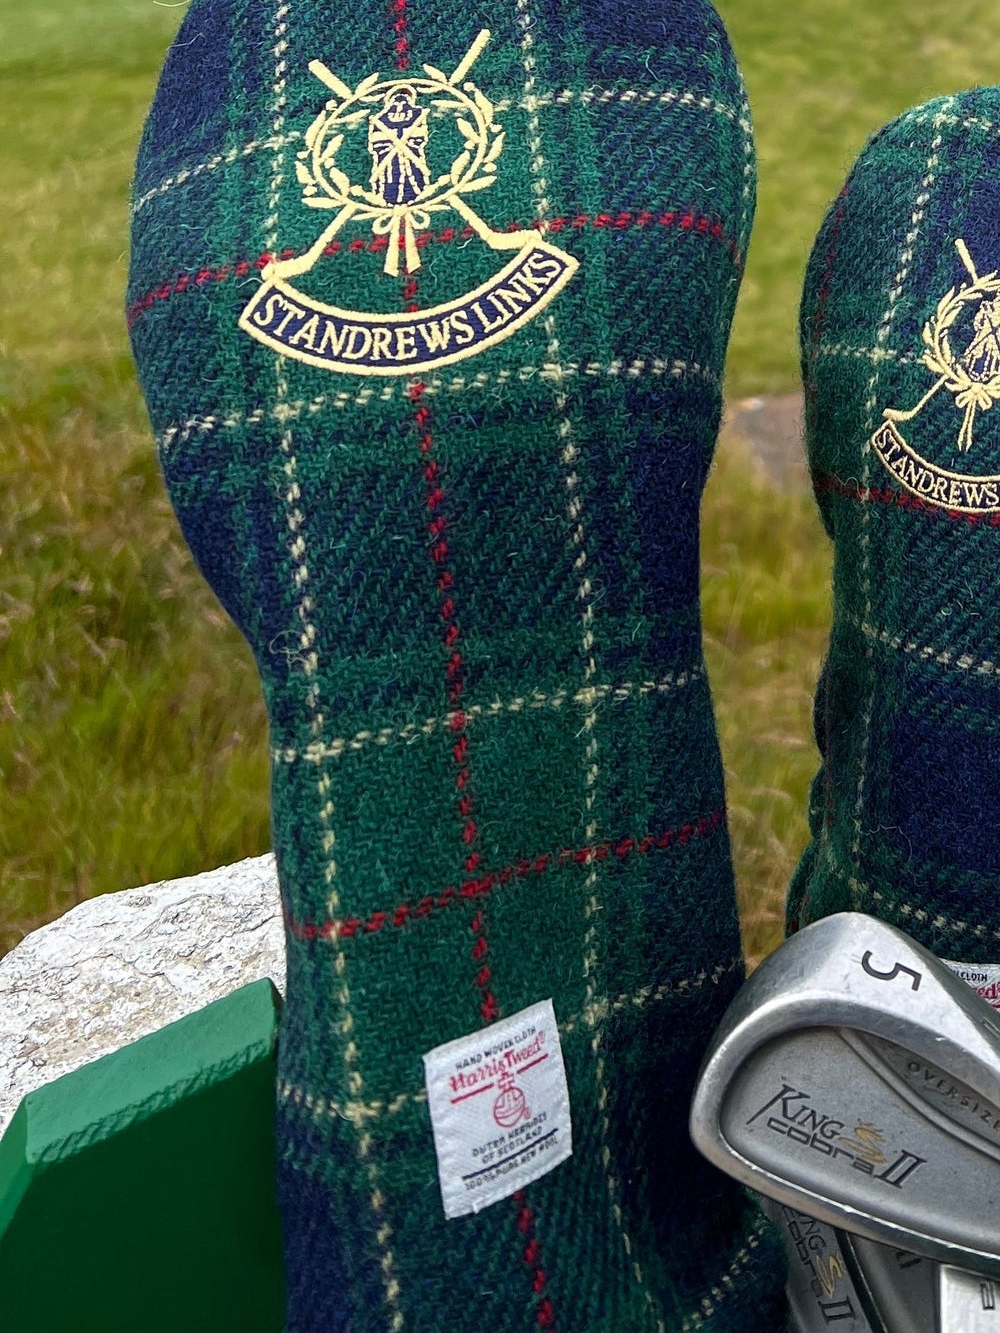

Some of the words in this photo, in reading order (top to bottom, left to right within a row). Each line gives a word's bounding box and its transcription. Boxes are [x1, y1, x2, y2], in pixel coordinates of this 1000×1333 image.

[253, 293, 306, 338] ST
[289, 309, 476, 361] ANDREWS
[473, 252, 563, 334] LINKS
[876, 428, 901, 462] ST
[891, 455, 1000, 507] ANDREWS
[861, 950, 923, 992] 5
[455, 1053, 483, 1071] HAND
[484, 1039, 514, 1057] WOVEN
[514, 1026, 537, 1043] CLOTH
[449, 1057, 506, 1092] Harris
[745, 1083, 846, 1140] KING
[497, 1125, 543, 1155] SCOTLAND
[766, 1116, 875, 1176] cobra
[873, 1149, 928, 1190] II
